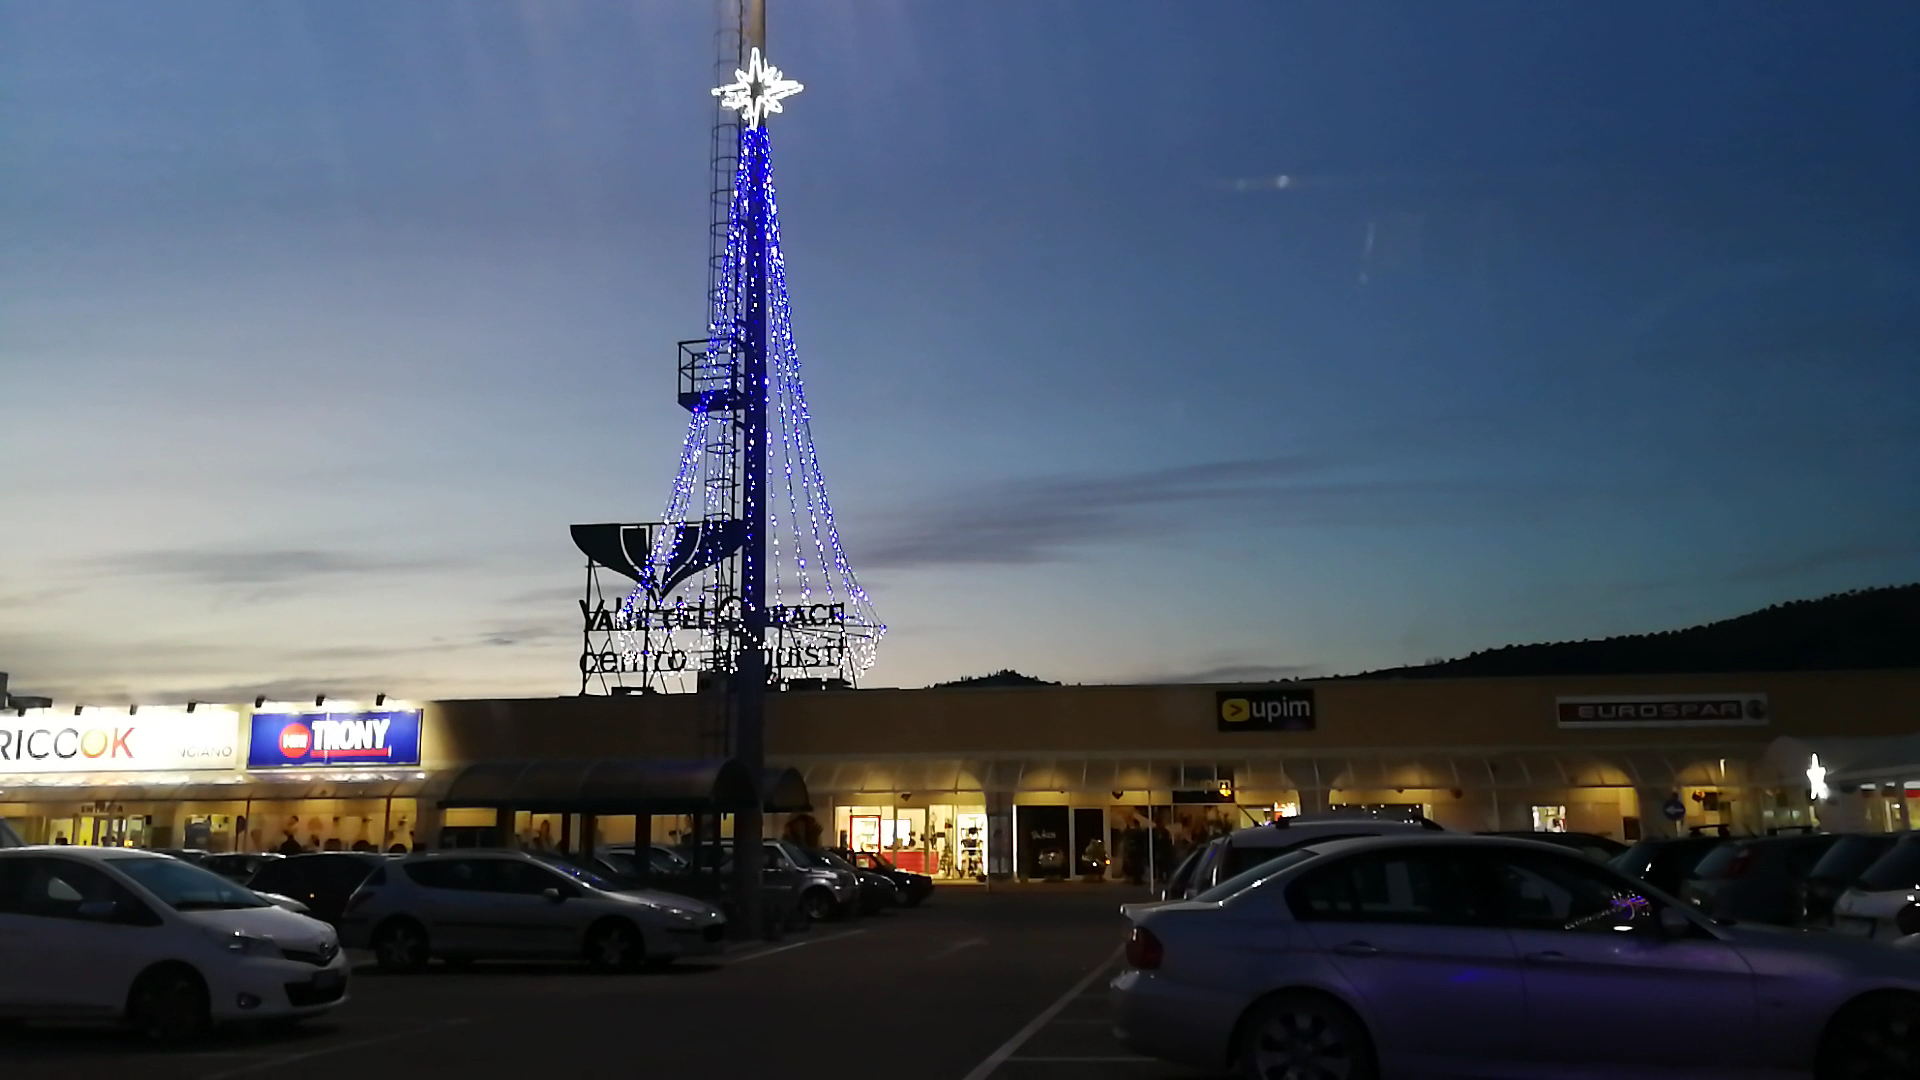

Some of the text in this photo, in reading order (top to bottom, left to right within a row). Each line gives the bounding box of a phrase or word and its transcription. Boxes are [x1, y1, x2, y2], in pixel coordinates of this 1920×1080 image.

[1252, 696, 1311, 723] upim
[1577, 702, 1739, 720] EUROSPAR
[312, 719, 391, 750] TRONY
